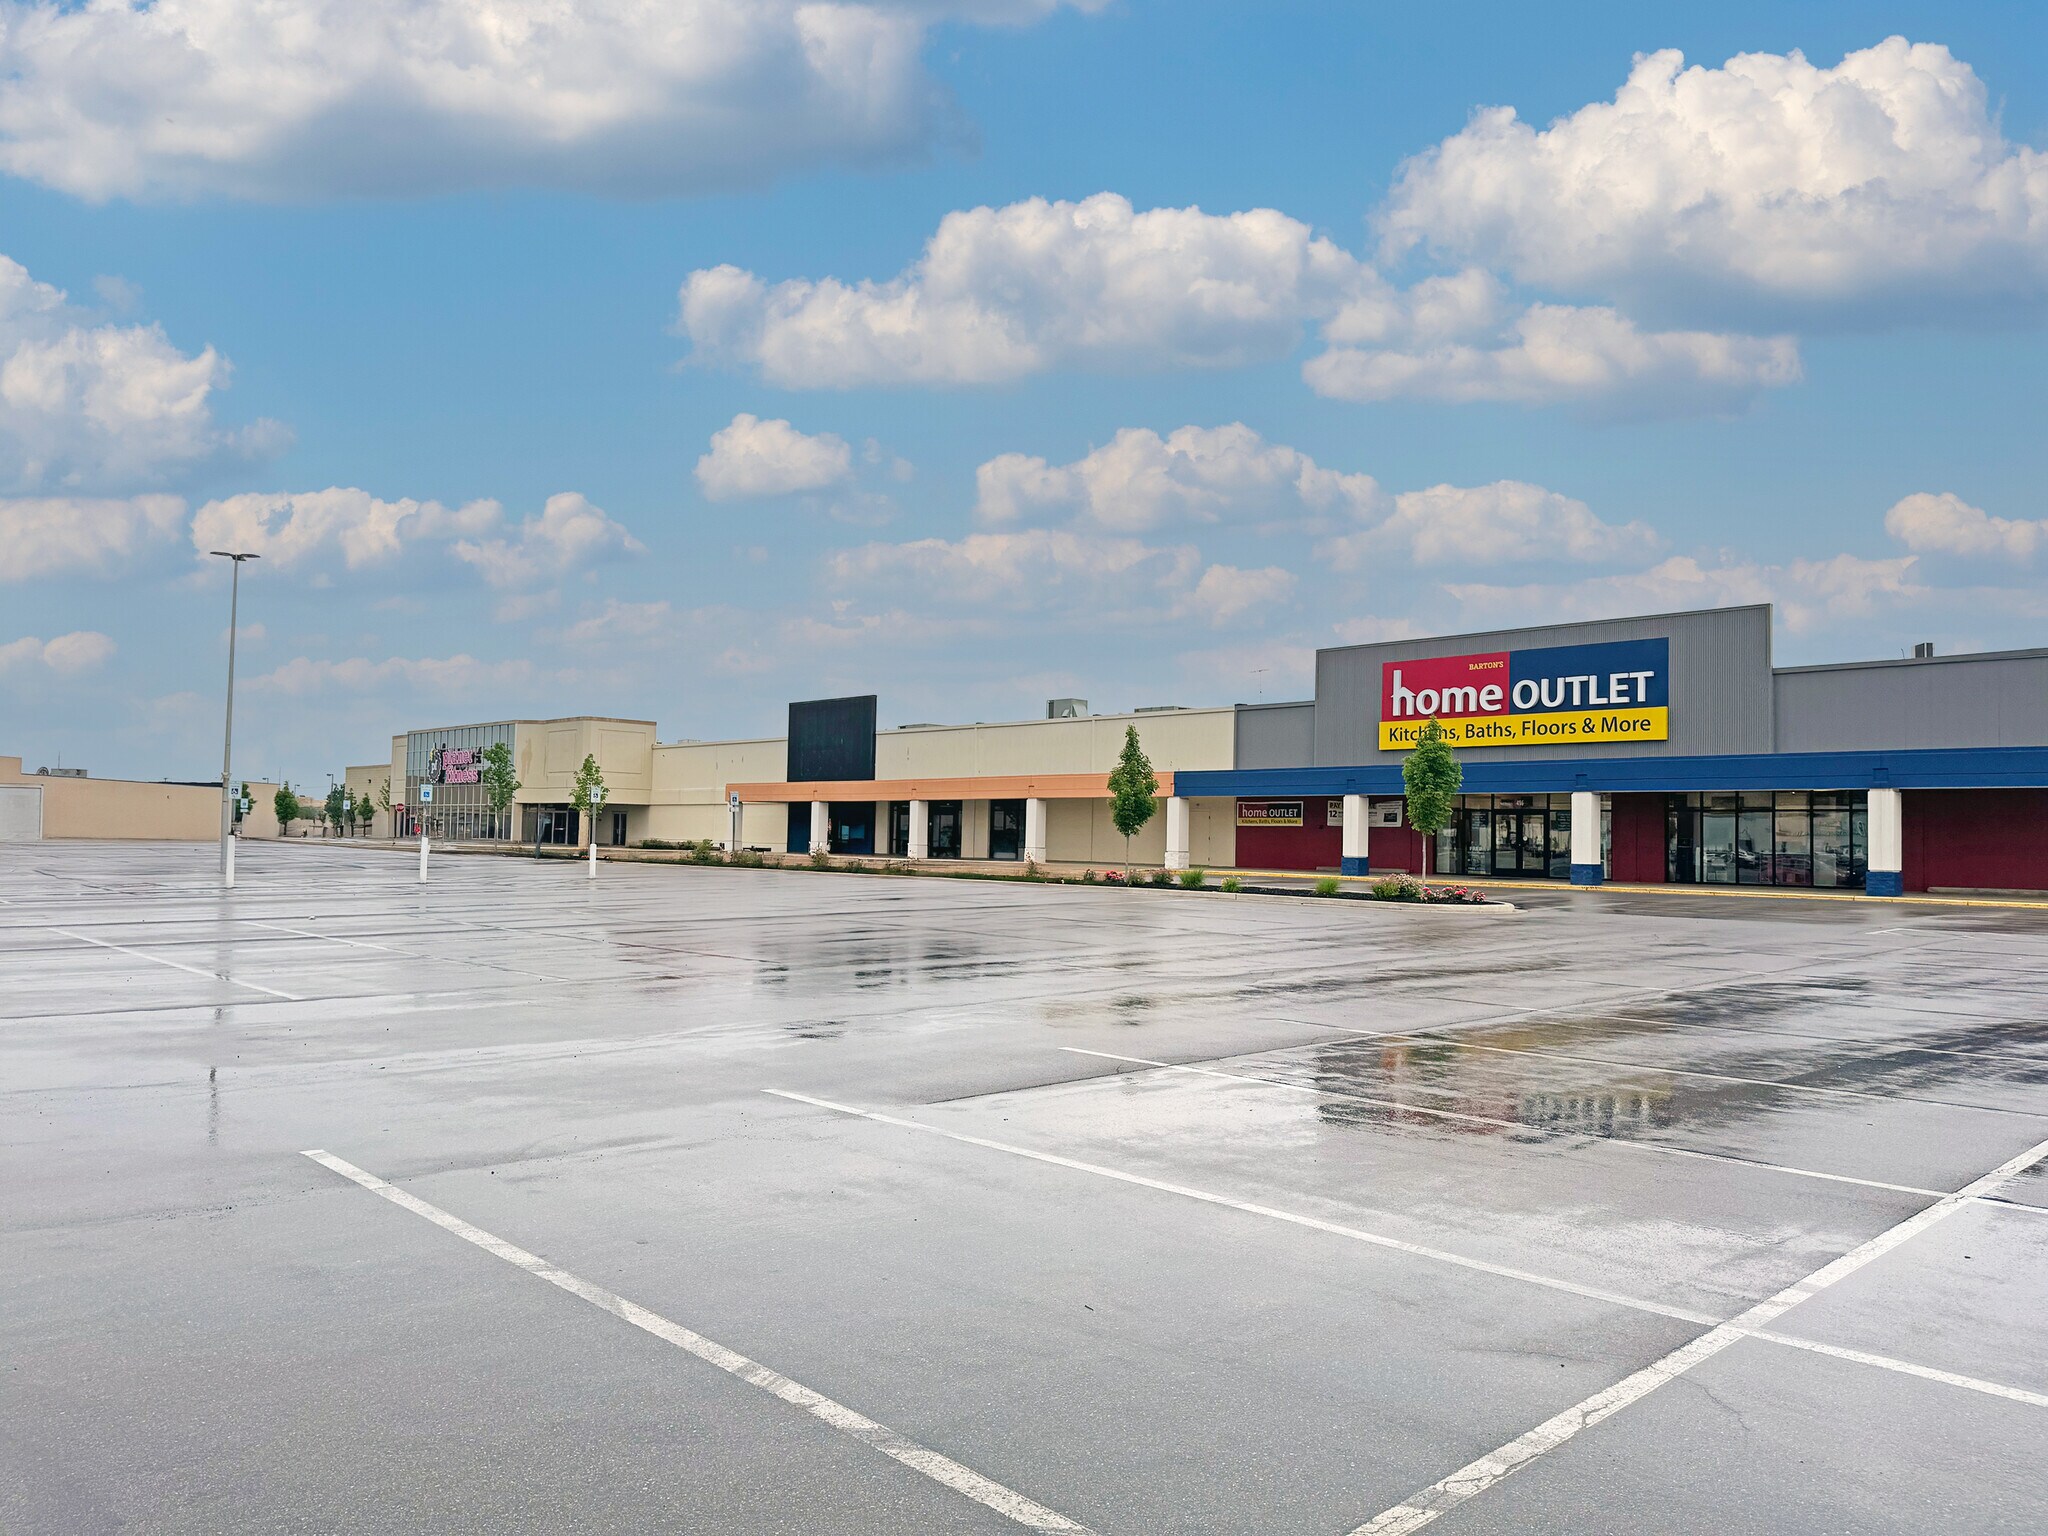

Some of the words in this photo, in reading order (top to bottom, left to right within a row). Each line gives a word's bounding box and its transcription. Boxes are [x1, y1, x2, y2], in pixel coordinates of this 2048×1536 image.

[1469, 661, 1504, 671] BARTON'S
[1391, 669, 1503, 716] home
[1512, 670, 1654, 710] OUTLET
[1389, 725, 1460, 742] Kitchns,
[1465, 721, 1517, 739] Baths,
[1522, 719, 1577, 736] Floors
[1581, 717, 1596, 734] &
[1601, 716, 1651, 733] More
[1242, 804, 1267, 817] home
[1268, 808, 1298, 817] OUTLET
[1329, 810, 1337, 818] 12
